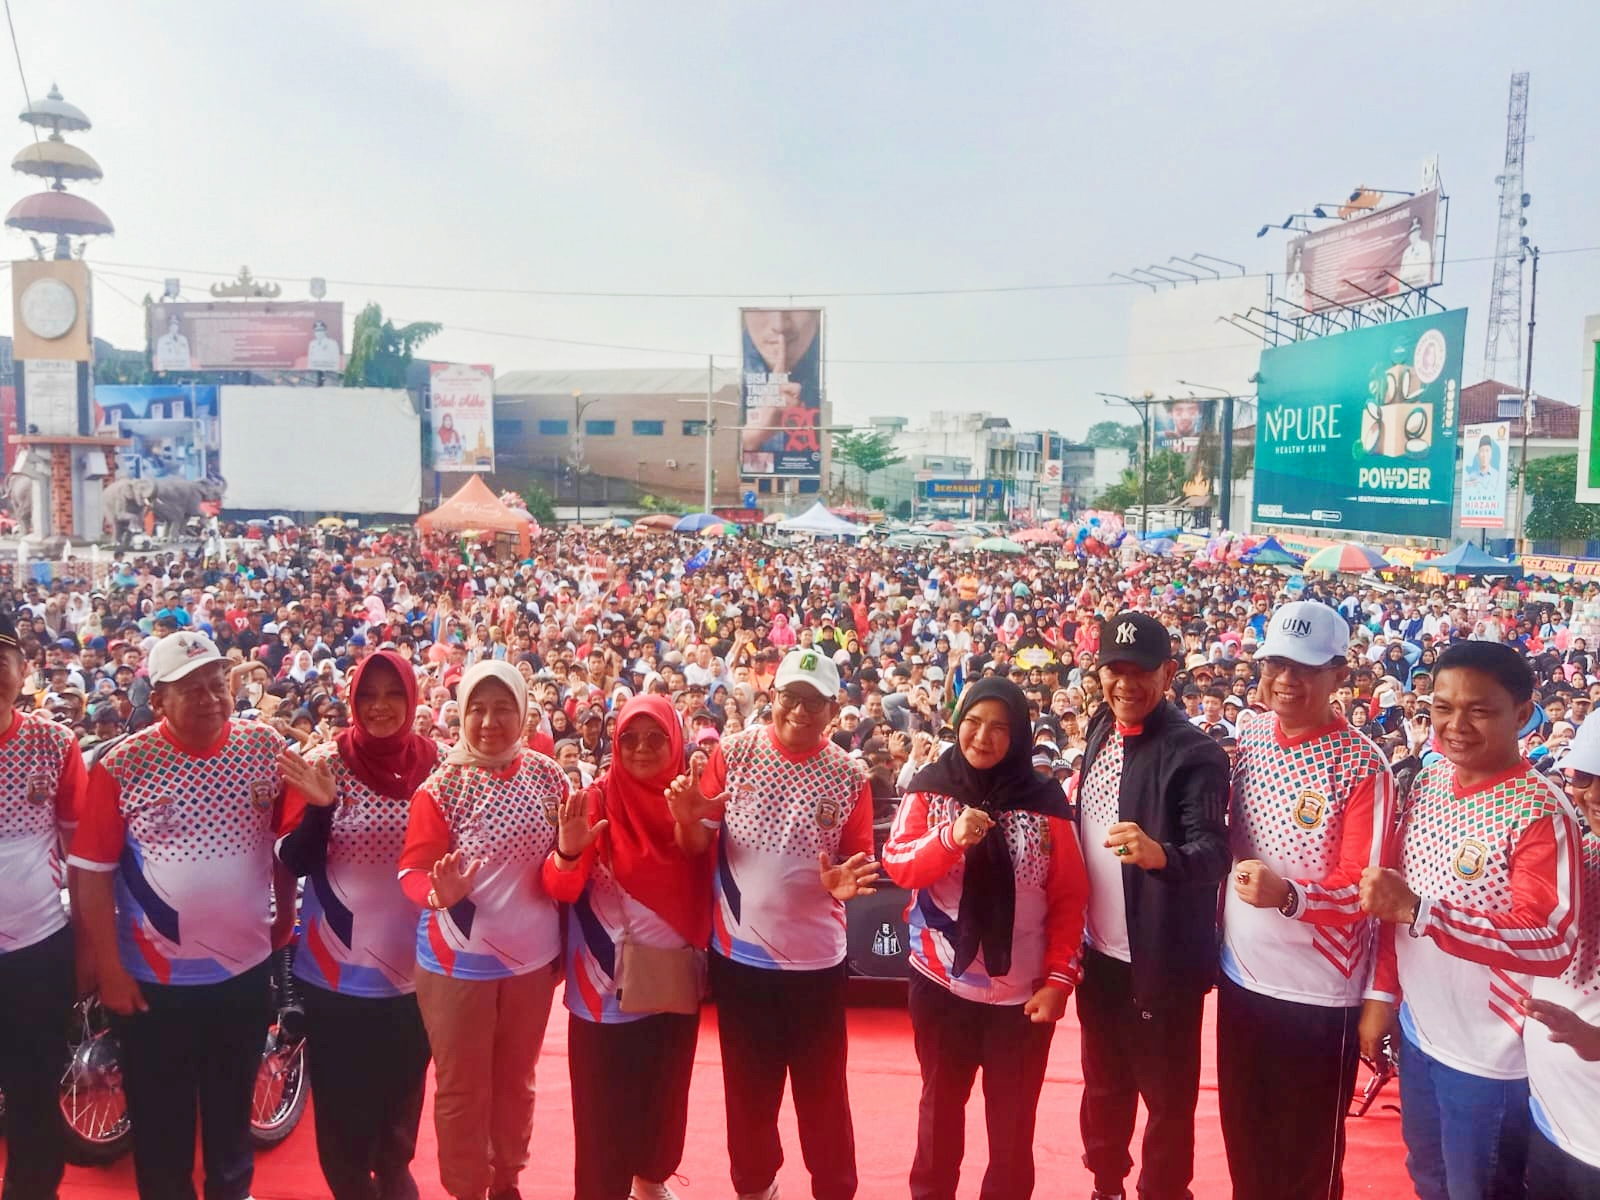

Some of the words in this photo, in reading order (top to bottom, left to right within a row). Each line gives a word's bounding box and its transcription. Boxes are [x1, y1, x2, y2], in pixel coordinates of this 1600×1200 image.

[1275, 445, 1305, 455] HEALTHY
[1307, 444, 1327, 454] SKIN
[1358, 467, 1431, 490] POWDER
[1464, 501, 1500, 509] MIRZANI
[1522, 559, 1569, 573] SELAMAT
[1282, 618, 1311, 634] UIN
